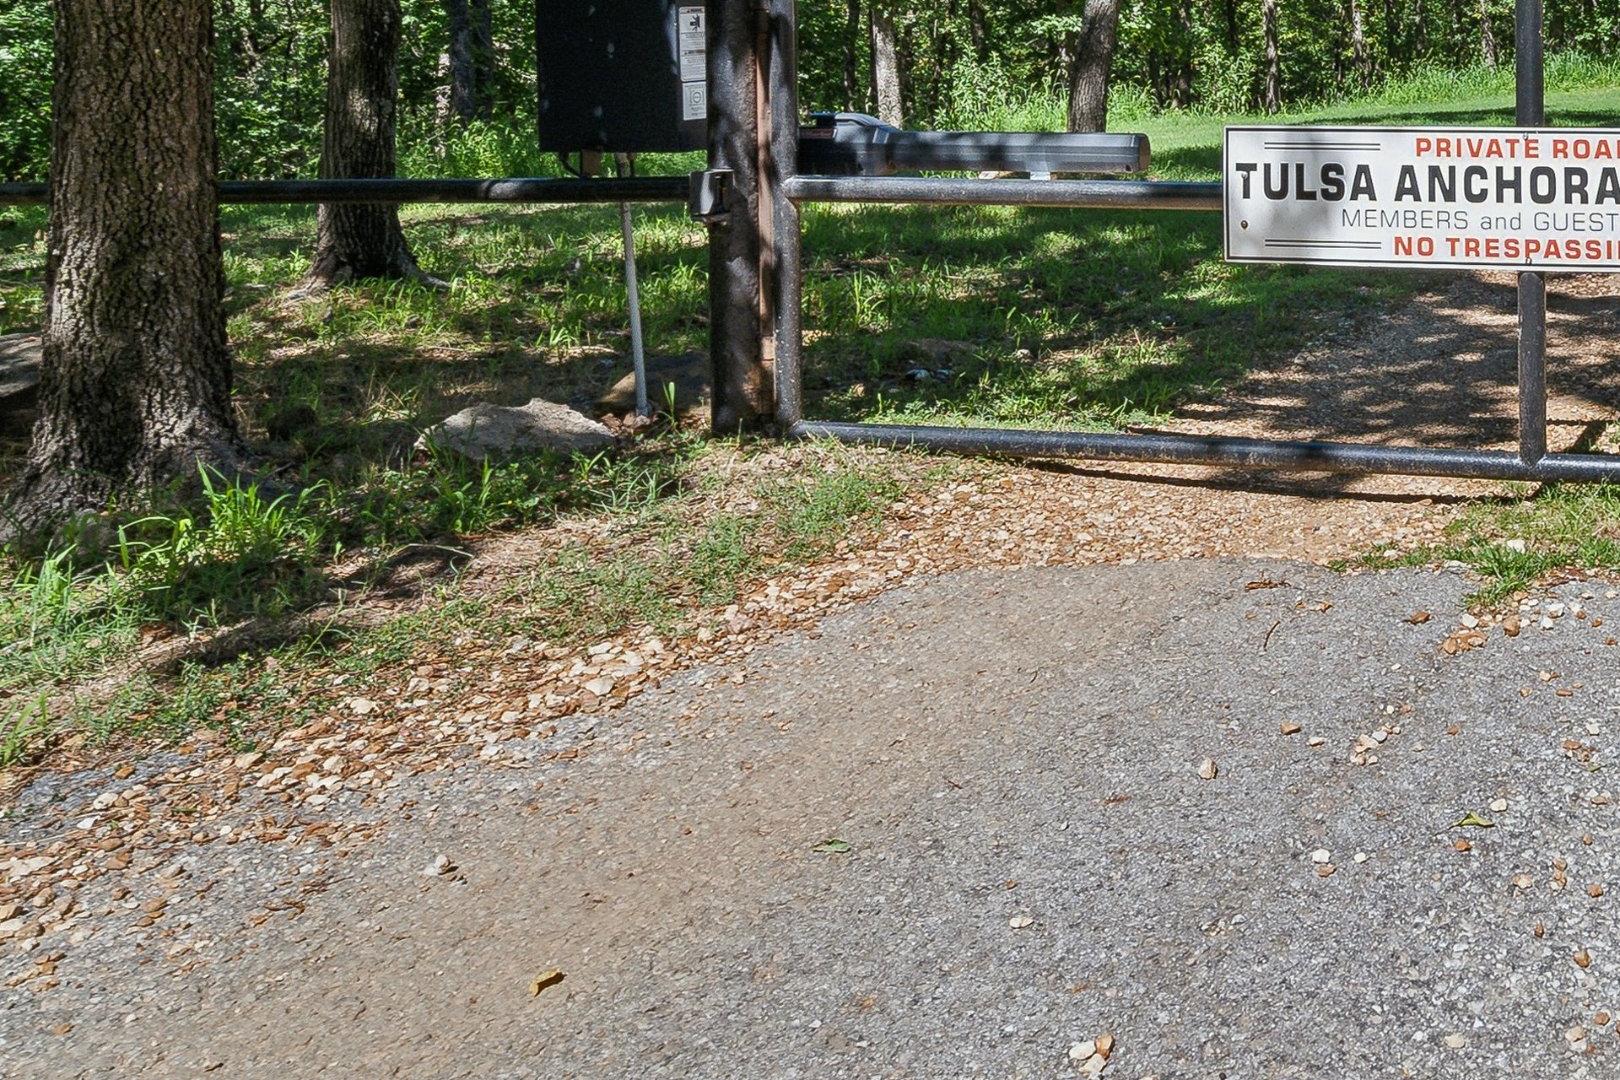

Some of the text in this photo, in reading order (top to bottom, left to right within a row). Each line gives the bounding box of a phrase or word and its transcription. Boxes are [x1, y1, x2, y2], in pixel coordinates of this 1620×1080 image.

[1415, 137, 1540, 159] PRIVATE
[1235, 162, 1378, 202] TULSA
[1342, 208, 1469, 230] MEMBERS
[1480, 212, 1522, 231] and
[1393, 236, 1434, 256] NO
